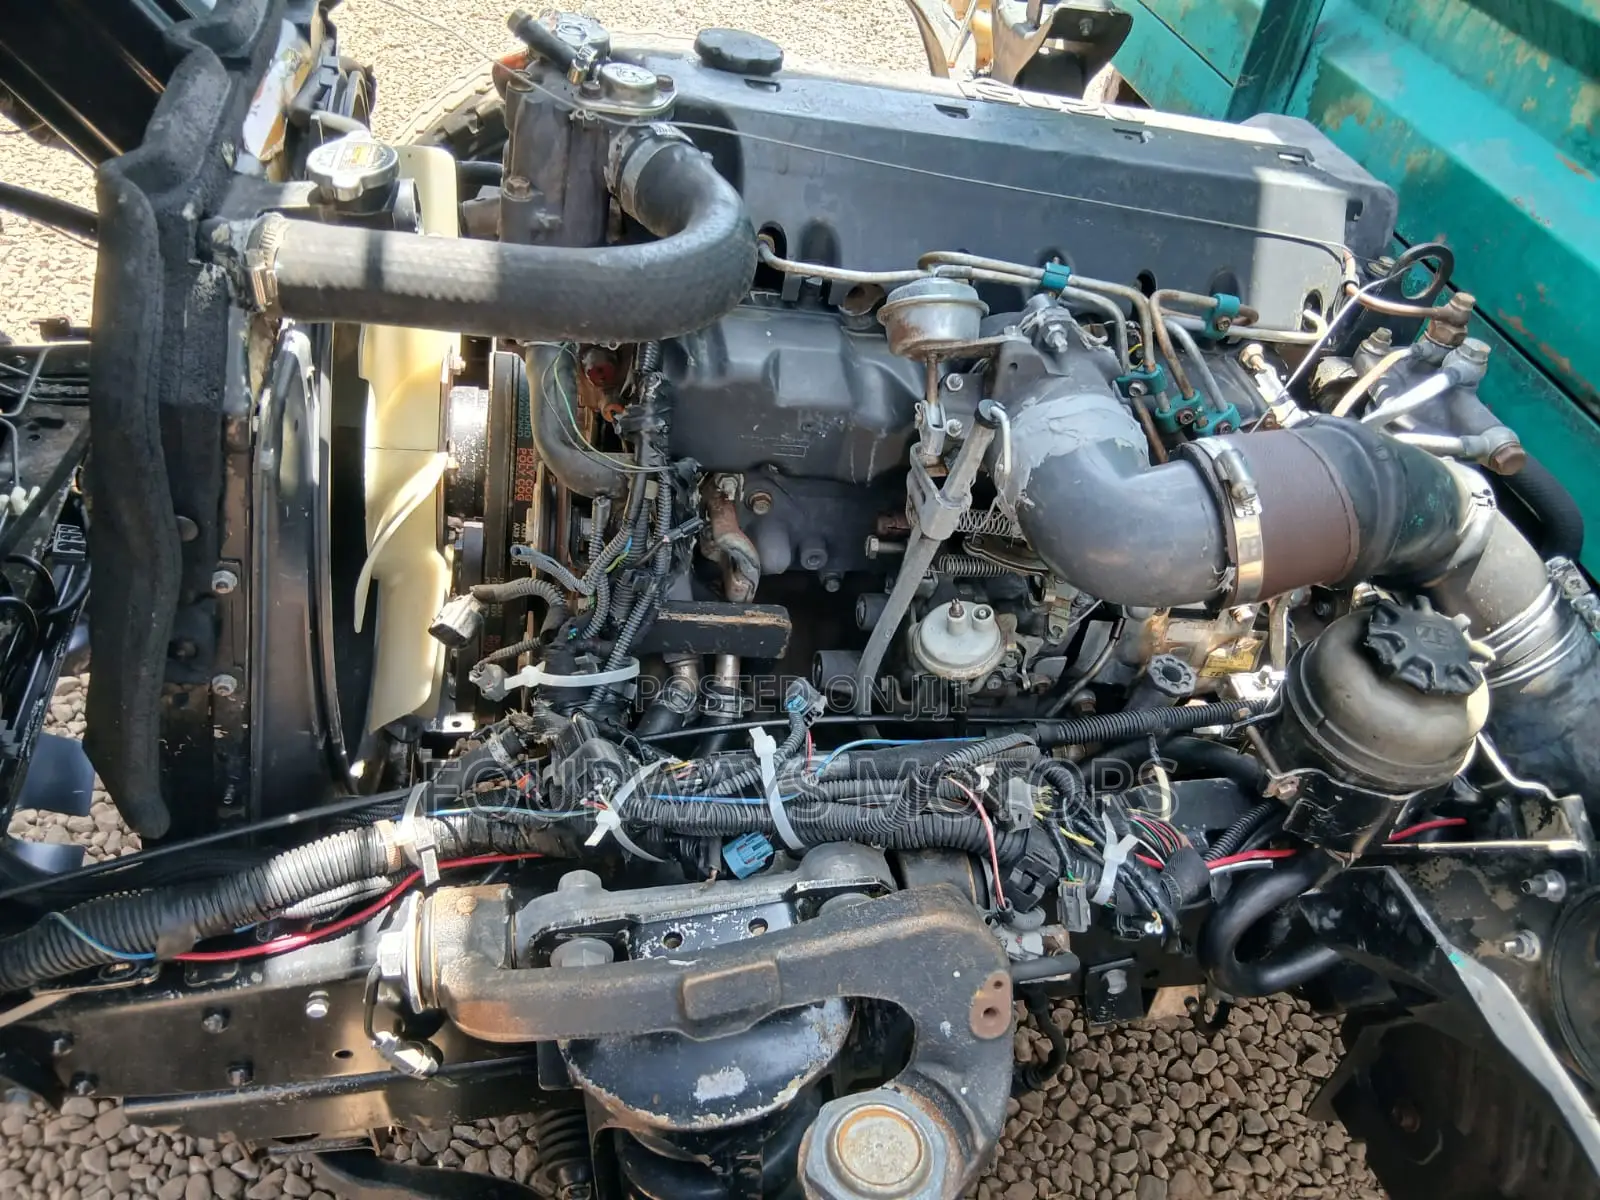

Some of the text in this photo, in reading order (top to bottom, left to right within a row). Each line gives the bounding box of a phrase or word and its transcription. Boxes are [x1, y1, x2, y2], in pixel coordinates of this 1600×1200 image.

[517, 447, 527, 501] POLY COG
[525, 448, 536, 501] POLY COG
